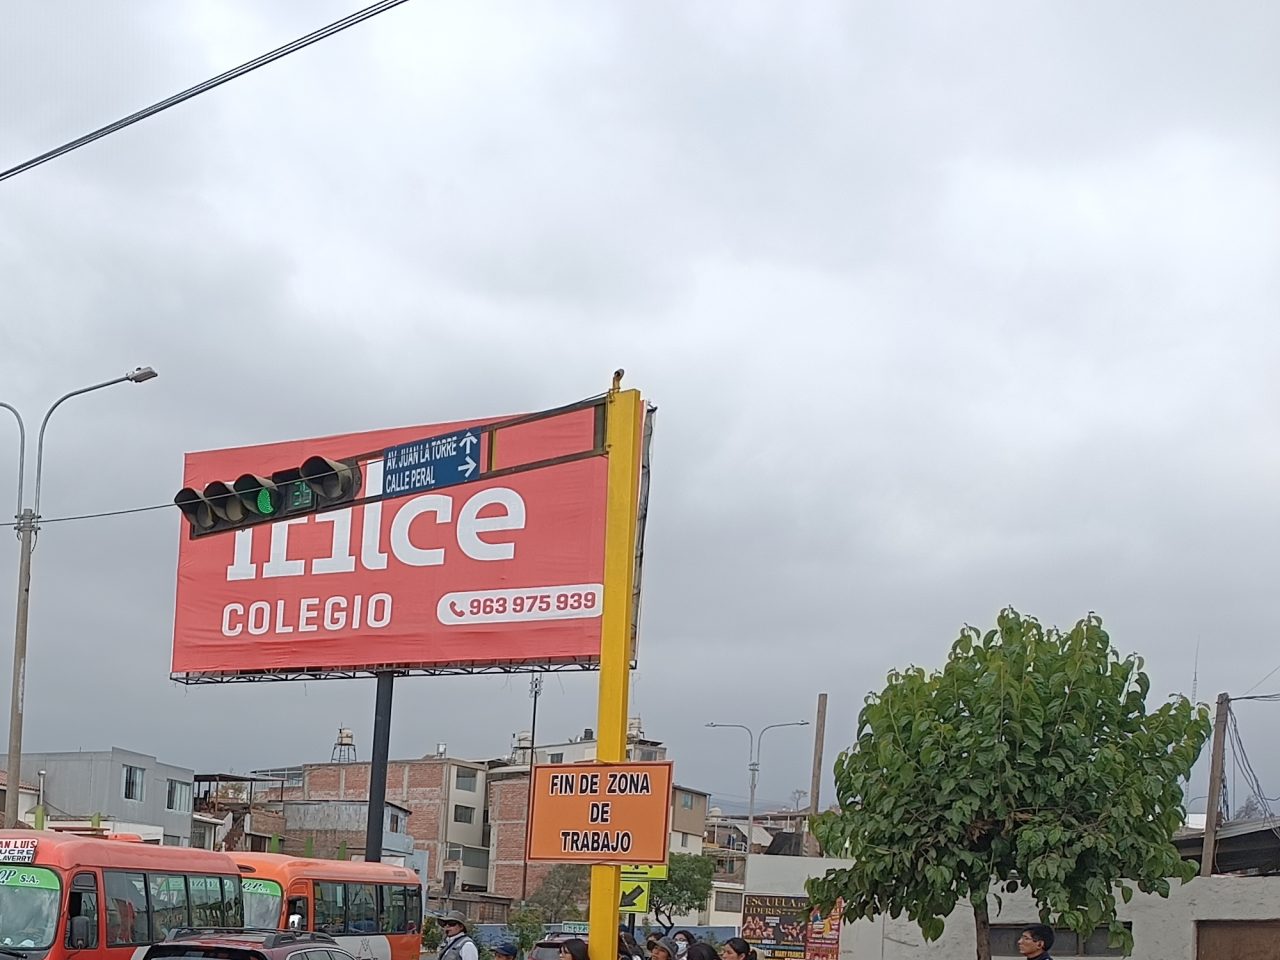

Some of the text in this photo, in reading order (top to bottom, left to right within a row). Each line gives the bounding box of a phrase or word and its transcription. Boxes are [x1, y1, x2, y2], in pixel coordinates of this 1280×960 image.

[386, 436, 458, 471] AV. JUAN LA TORRE
[385, 465, 436, 493] CALLE PERAL
[468, 591, 597, 616] 963 975 939
[222, 593, 392, 637] COLEGIO
[550, 772, 651, 795] FIN DE ZONA
[589, 802, 611, 824] DE
[14, 840, 36, 849] LUIS
[560, 831, 631, 853] TRABAJO
[19, 874, 40, 884] S.A.
[745, 896, 796, 907] ESCUELA
